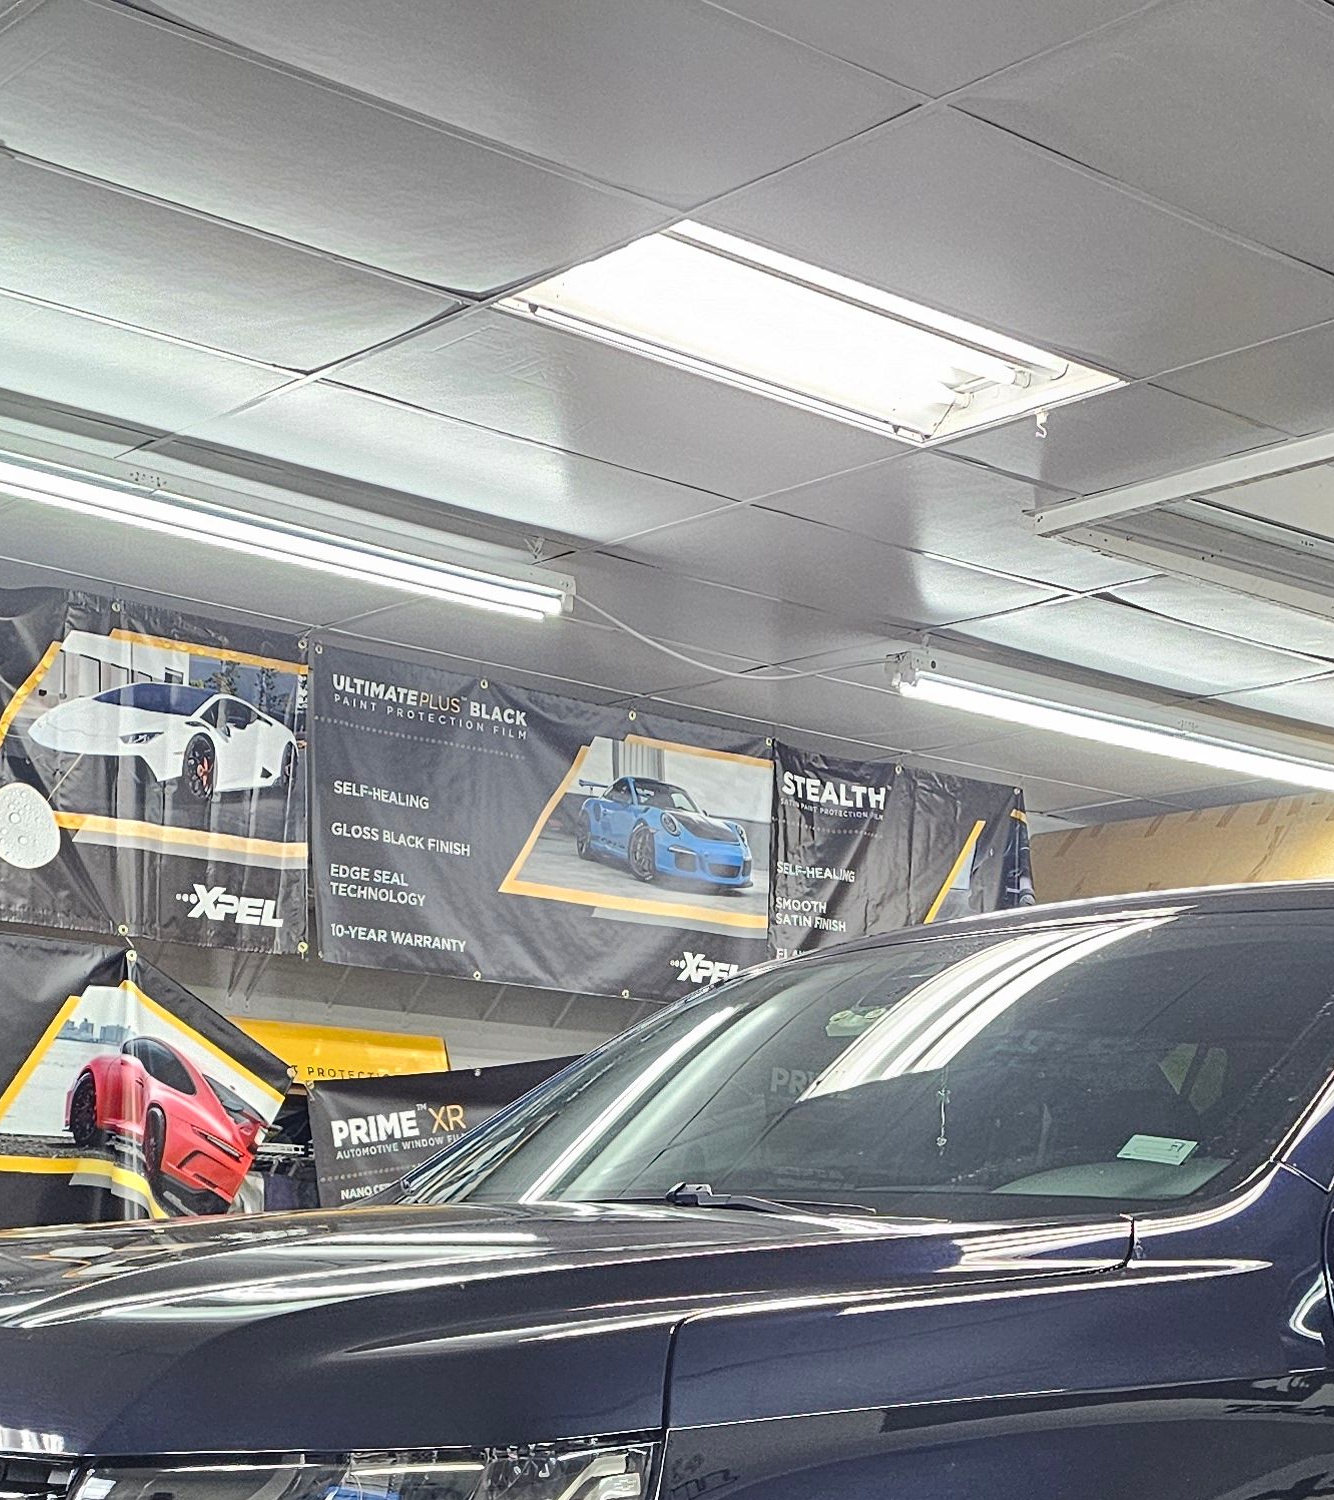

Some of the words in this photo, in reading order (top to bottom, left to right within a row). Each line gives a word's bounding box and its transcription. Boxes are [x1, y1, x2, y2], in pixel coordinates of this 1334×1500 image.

[334, 693, 376, 712] PAINT
[387, 705, 484, 732] PROTECTION
[494, 726, 527, 740] FILM
[470, 702, 527, 727] BLACK
[333, 780, 430, 809] SELF-HEALING
[820, 808, 868, 818] PROTECTION
[331, 822, 380, 842] GLOSS
[383, 830, 425, 850] BLACK
[428, 839, 471, 857] FINISH
[330, 864, 370, 882] EDGE
[373, 871, 408, 887] SEAL
[777, 861, 855, 882] SELF-HEALING
[187, 883, 284, 928] XPEL
[330, 882, 426, 907] TECHNOLOGY
[776, 897, 827, 913] SMOOTH
[776, 913, 812, 928] SATIN
[814, 917, 846, 932] FINISH
[330, 923, 387, 943] 10-YEAR
[391, 932, 466, 953] WARRANTY
[428, 1104, 466, 1133] XR
[336, 1140, 399, 1160] AUTOMOTIVE
[402, 1136, 444, 1149] WINDOW
[341, 1186, 372, 1200] NANO
